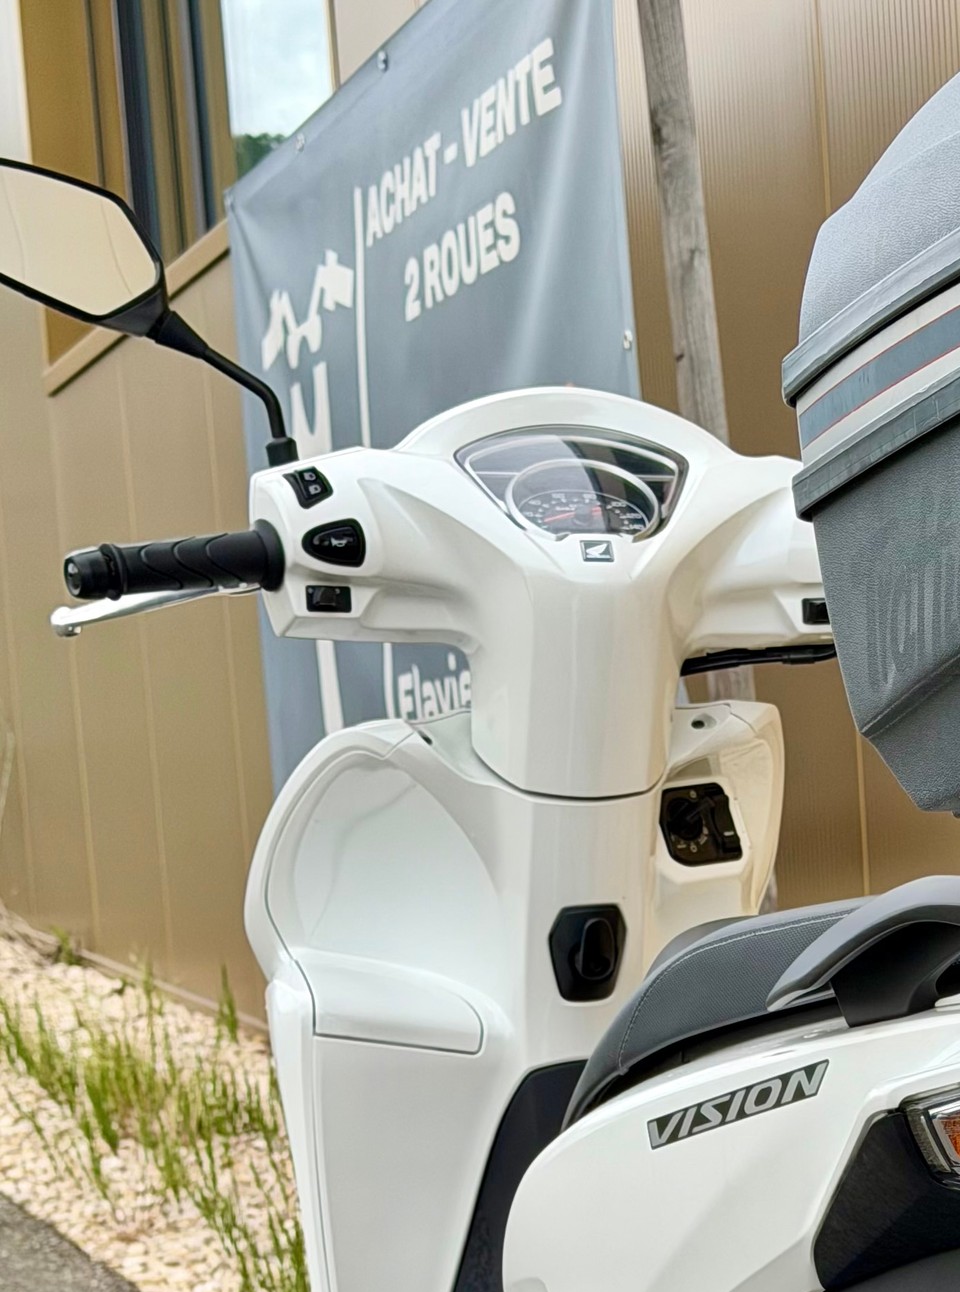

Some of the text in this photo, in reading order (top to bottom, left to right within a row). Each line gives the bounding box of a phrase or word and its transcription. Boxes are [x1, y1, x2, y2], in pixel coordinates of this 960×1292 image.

[404, 191, 521, 323] 2 ROUES
[649, 1062, 829, 1148] VISION
